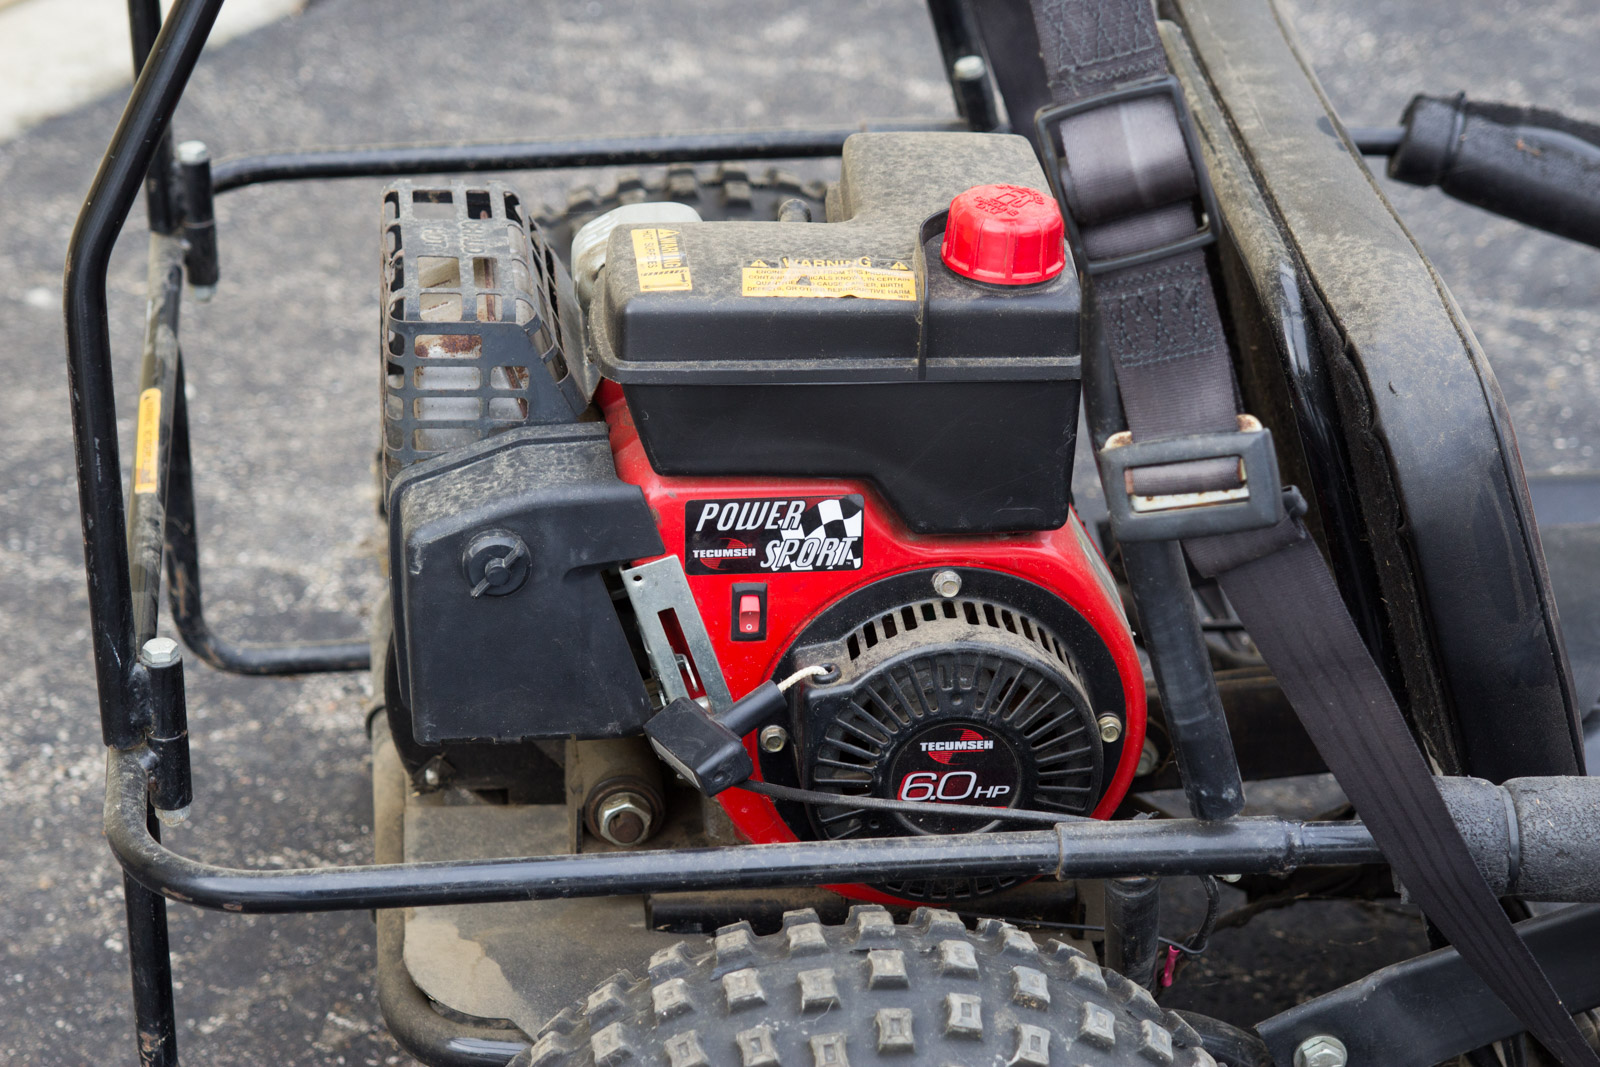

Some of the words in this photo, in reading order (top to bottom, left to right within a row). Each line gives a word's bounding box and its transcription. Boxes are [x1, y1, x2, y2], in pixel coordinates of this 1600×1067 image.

[695, 500, 806, 532] POWER
[692, 547, 757, 559] TECUMSEH
[760, 536, 859, 569] SPORT
[920, 740, 994, 752] TECUMSEH
